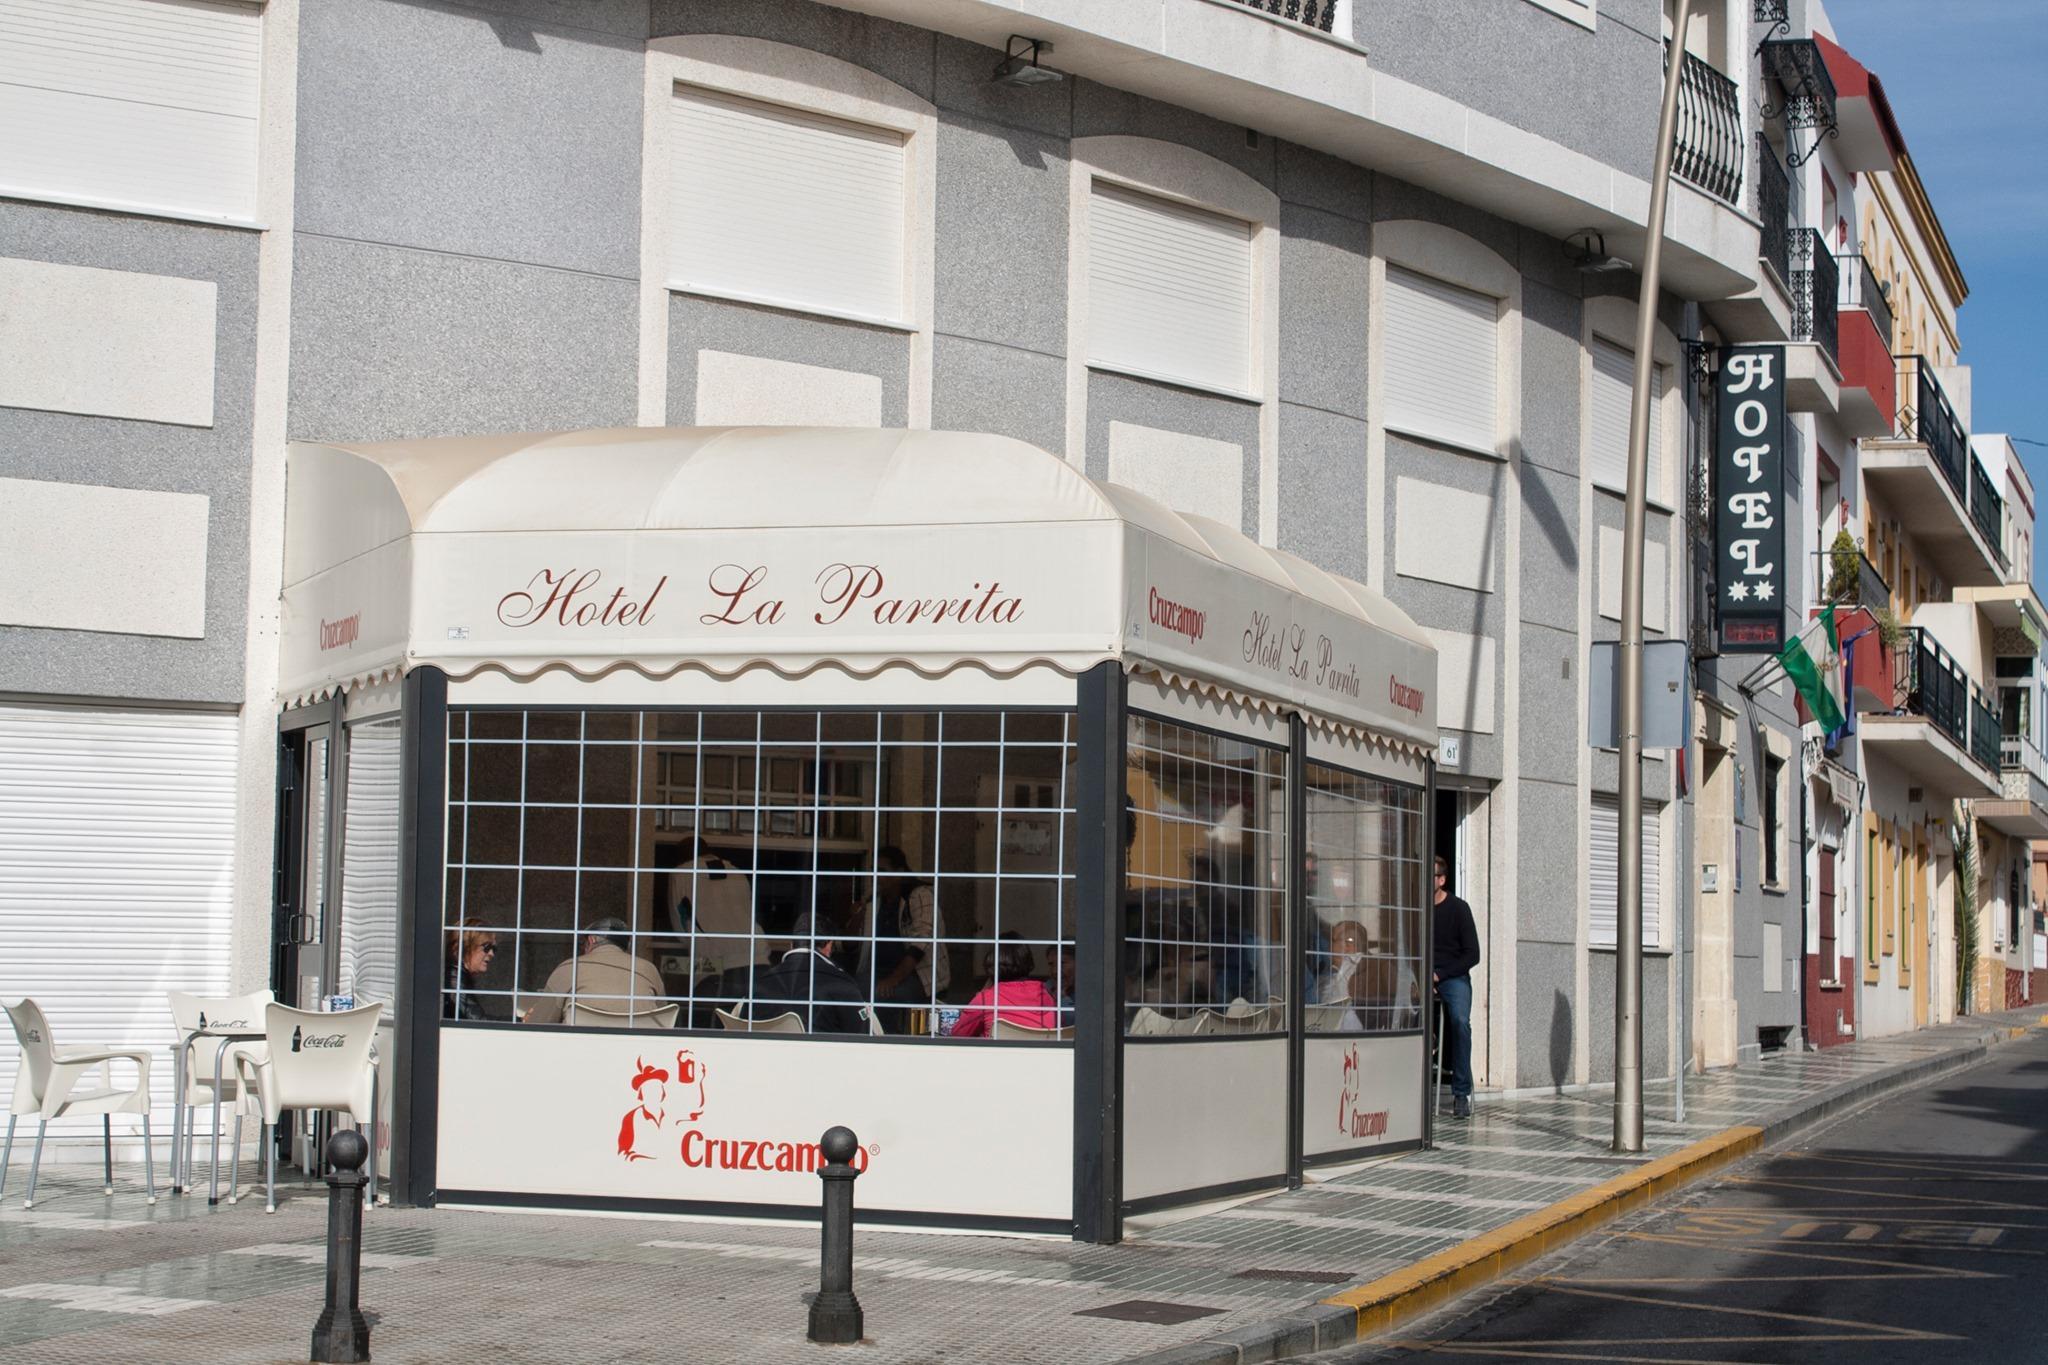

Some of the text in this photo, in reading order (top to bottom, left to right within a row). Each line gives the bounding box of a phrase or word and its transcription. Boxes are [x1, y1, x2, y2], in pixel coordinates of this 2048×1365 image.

[1726, 353, 1774, 575] HOTEL
[497, 562, 1025, 628] Hotel La Parrita
[1149, 586, 1204, 645] Cruzcampo
[319, 613, 360, 651] Cruzcampo
[1242, 610, 1360, 698] Hotel La Parrita
[1389, 673, 1424, 718] Cruzcampo
[681, 1129, 869, 1175] Cruzcamo
